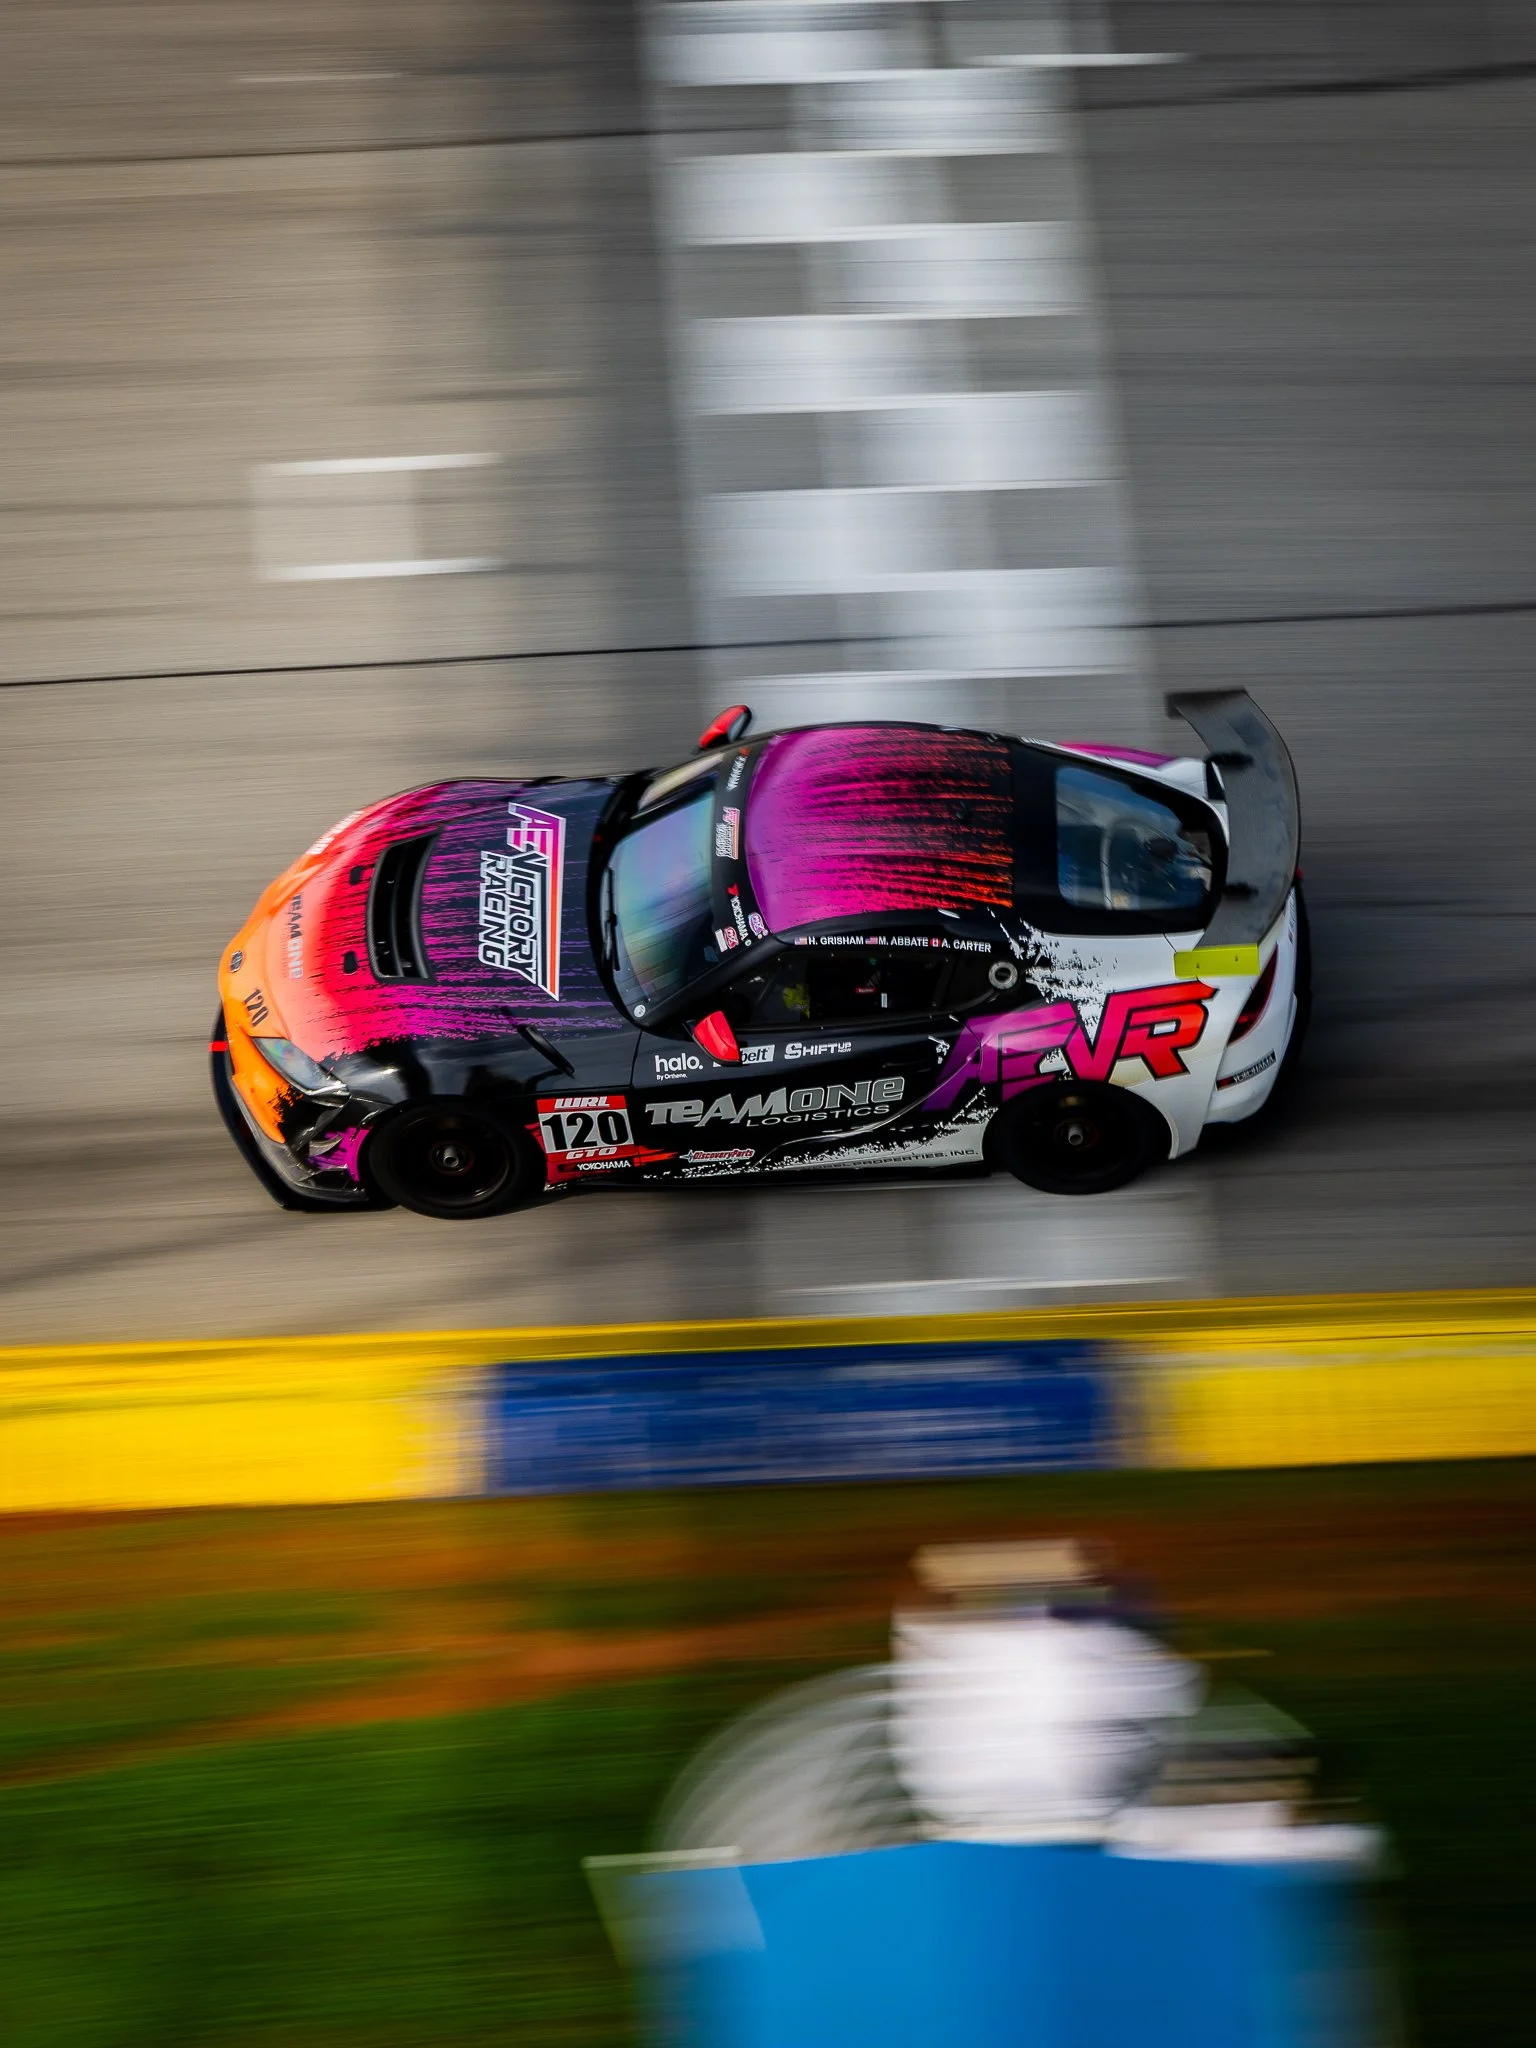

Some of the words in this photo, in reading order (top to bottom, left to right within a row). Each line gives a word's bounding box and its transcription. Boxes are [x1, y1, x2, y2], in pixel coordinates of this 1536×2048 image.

[478, 850, 511, 968] RACING
[808, 936, 818, 945] H.
[820, 936, 864, 945] GRISHAM
[878, 936, 888, 946] M.
[890, 937, 929, 947] ABBATE
[941, 938, 951, 949] A.
[953, 940, 992, 953] CARTER
[243, 987, 270, 1028] 120
[784, 1042, 838, 1060] SHIFT
[654, 1052, 704, 1073] halo.
[656, 1074, 664, 1082] By
[554, 1096, 610, 1109] WRL
[746, 1104, 890, 1127] LOGISTICS
[542, 1110, 629, 1151] 120
[565, 1147, 618, 1160] GTO
[950, 1149, 979, 1157] INC.
[576, 1160, 632, 1171] YOKOHAMA
